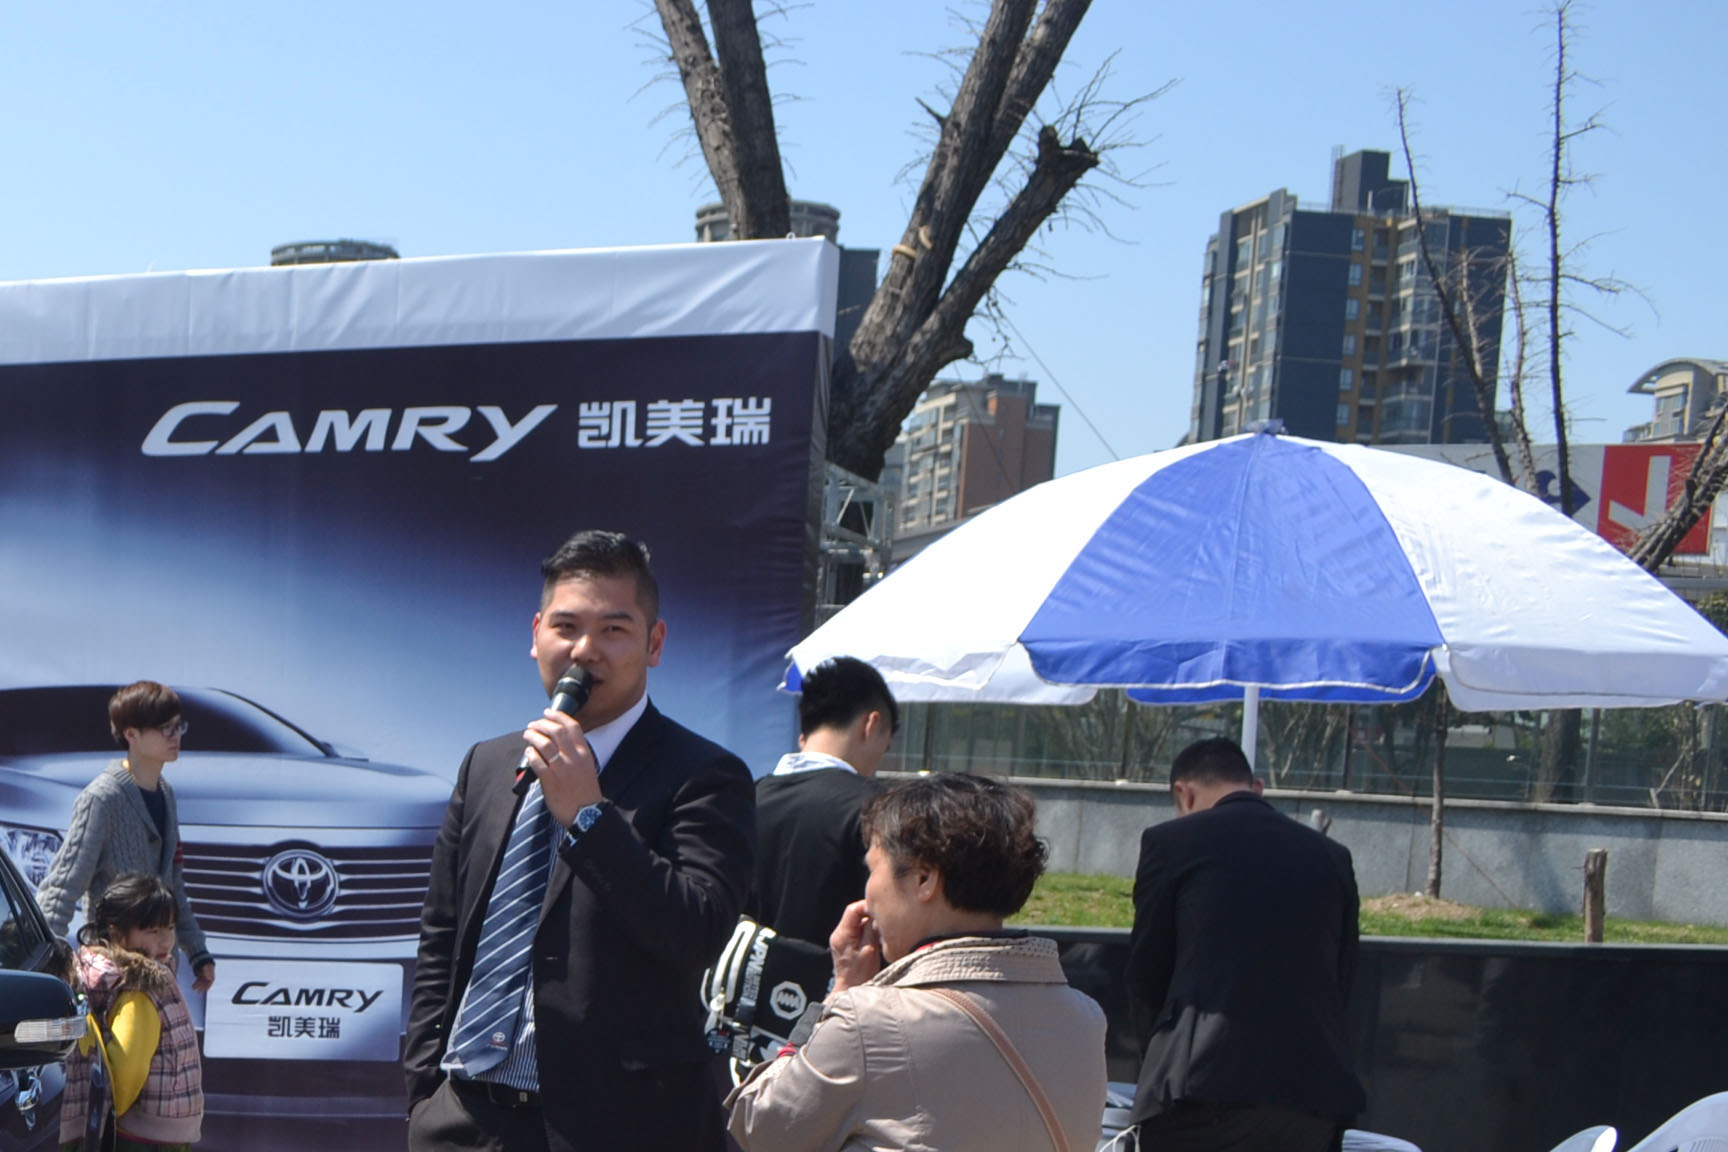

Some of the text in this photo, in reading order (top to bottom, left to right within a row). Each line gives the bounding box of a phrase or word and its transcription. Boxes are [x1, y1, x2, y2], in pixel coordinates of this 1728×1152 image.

[141, 396, 772, 462] CAMRY 凯美瑞
[231, 981, 384, 1013] CAMRY
[267, 1015, 341, 1039] 凯美瑞
